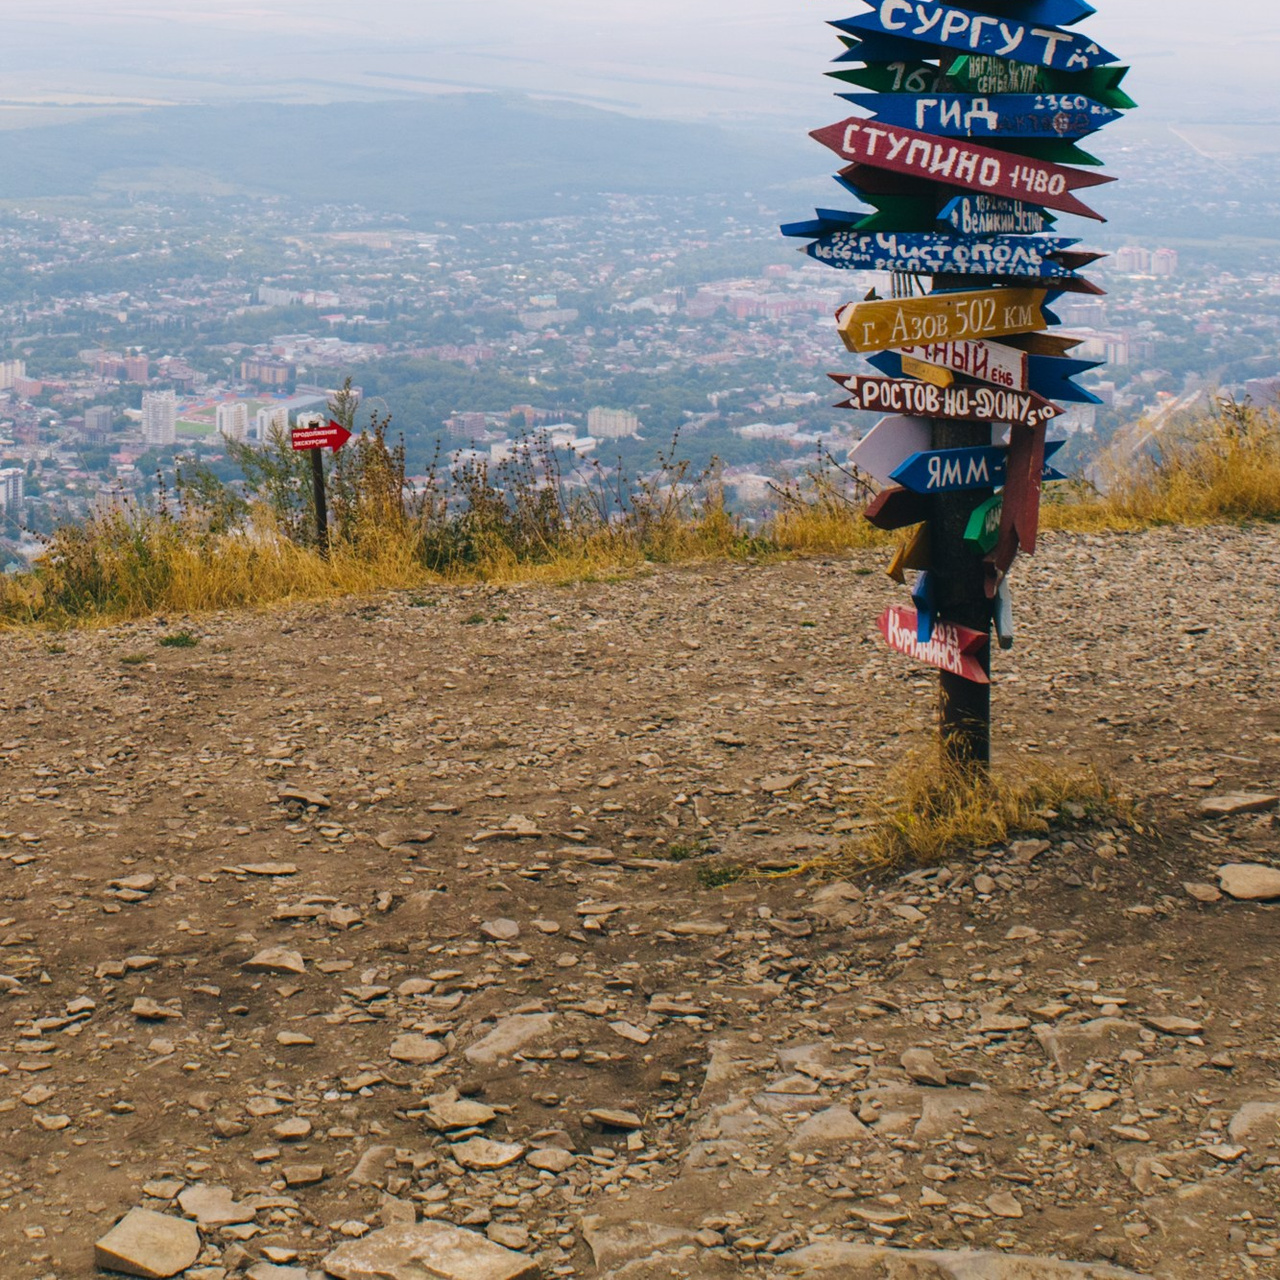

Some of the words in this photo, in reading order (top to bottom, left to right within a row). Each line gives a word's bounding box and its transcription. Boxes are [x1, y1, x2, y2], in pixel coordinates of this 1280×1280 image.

[915, 97, 999, 131] ГИД
[1034, 95, 1088, 111] 2360
[842, 123, 1001, 187] СТУПИНО
[863, 322, 879, 346] г.
[955, 298, 997, 337] 502
[1028, 404, 1055, 426] 510
[292, 429, 338, 438] ПРОДОЛЖЕНИЕ
[294, 439, 328, 447] ЭКСКУРСИИ
[933, 622, 959, 646] 2023
